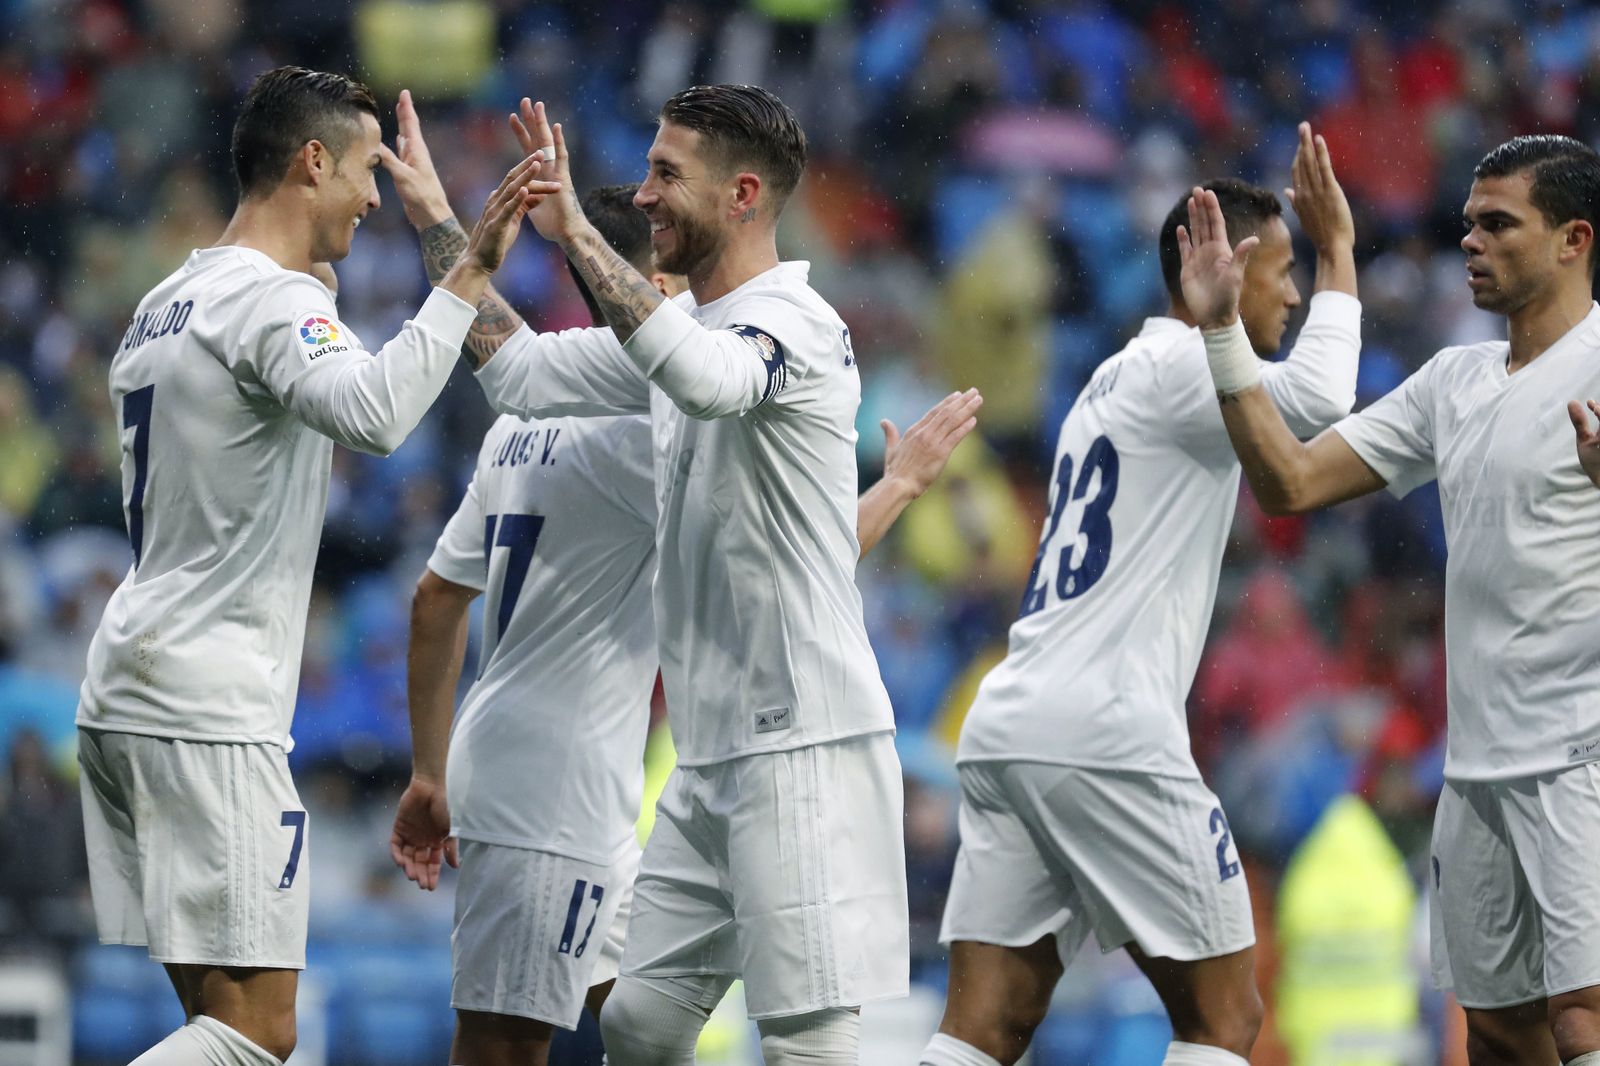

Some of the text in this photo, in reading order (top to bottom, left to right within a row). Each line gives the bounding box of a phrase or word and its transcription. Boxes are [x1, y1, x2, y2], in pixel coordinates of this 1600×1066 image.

[122, 300, 194, 350] ONALDO
[308, 344, 348, 361] LaLiga
[122, 384, 155, 573] 7
[541, 428, 561, 466] V.
[1018, 435, 1120, 620] 23
[279, 811, 306, 888] 7
[558, 879, 604, 958] 17
